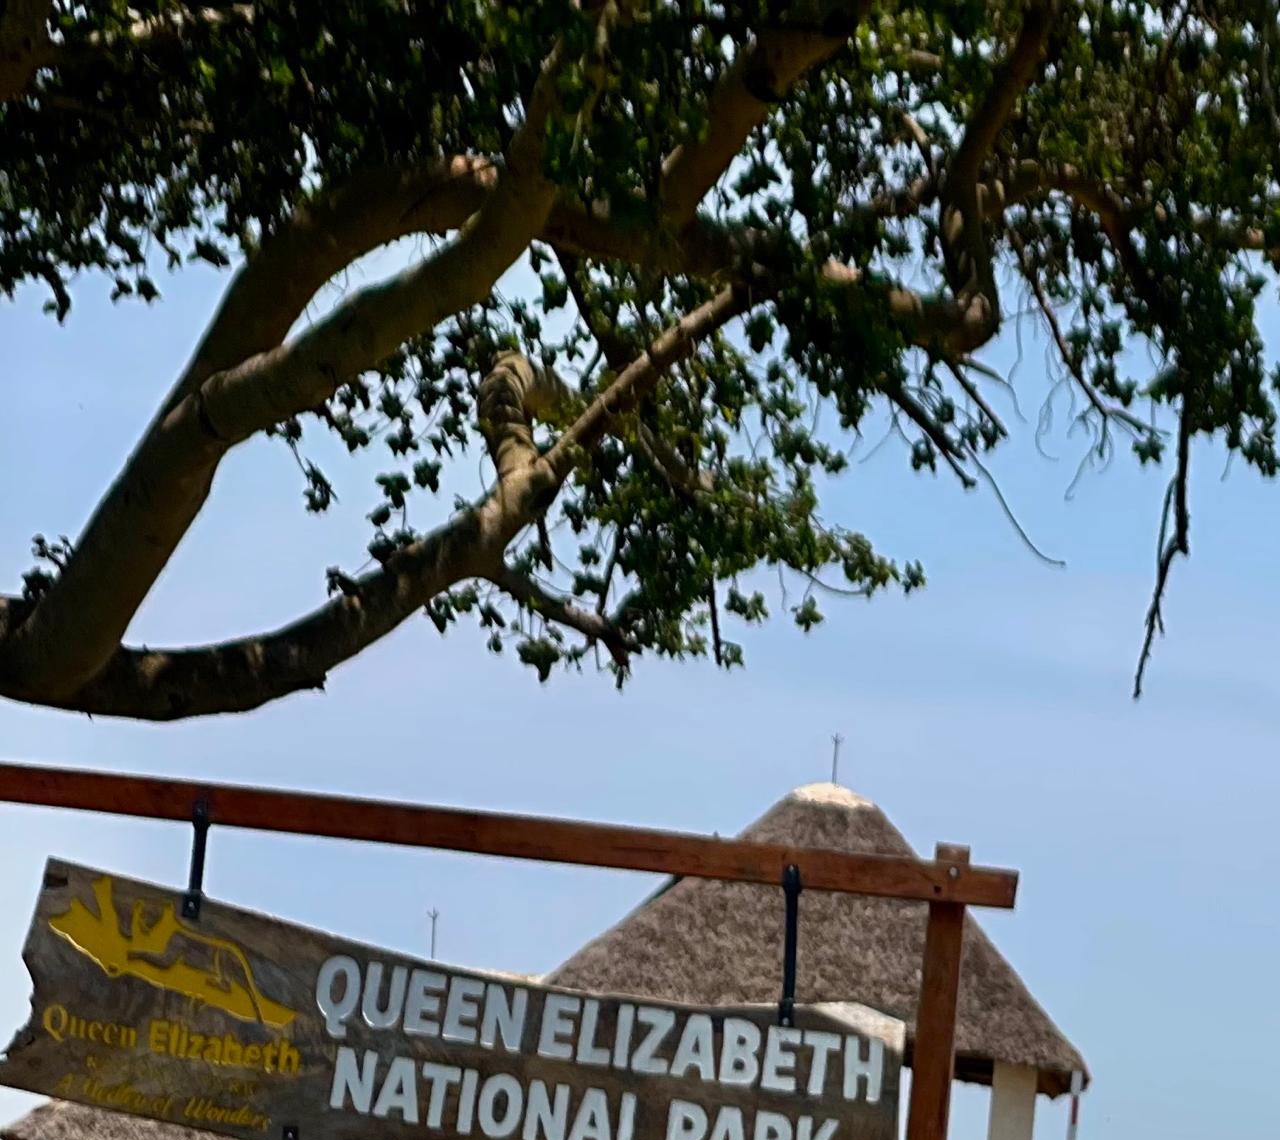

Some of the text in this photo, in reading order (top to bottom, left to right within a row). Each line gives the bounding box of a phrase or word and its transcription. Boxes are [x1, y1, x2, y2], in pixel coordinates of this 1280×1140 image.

[42, 1004, 300, 1075] Queen Elizabeth
[316, 955, 885, 1103] QUEEN ELIZABETH
